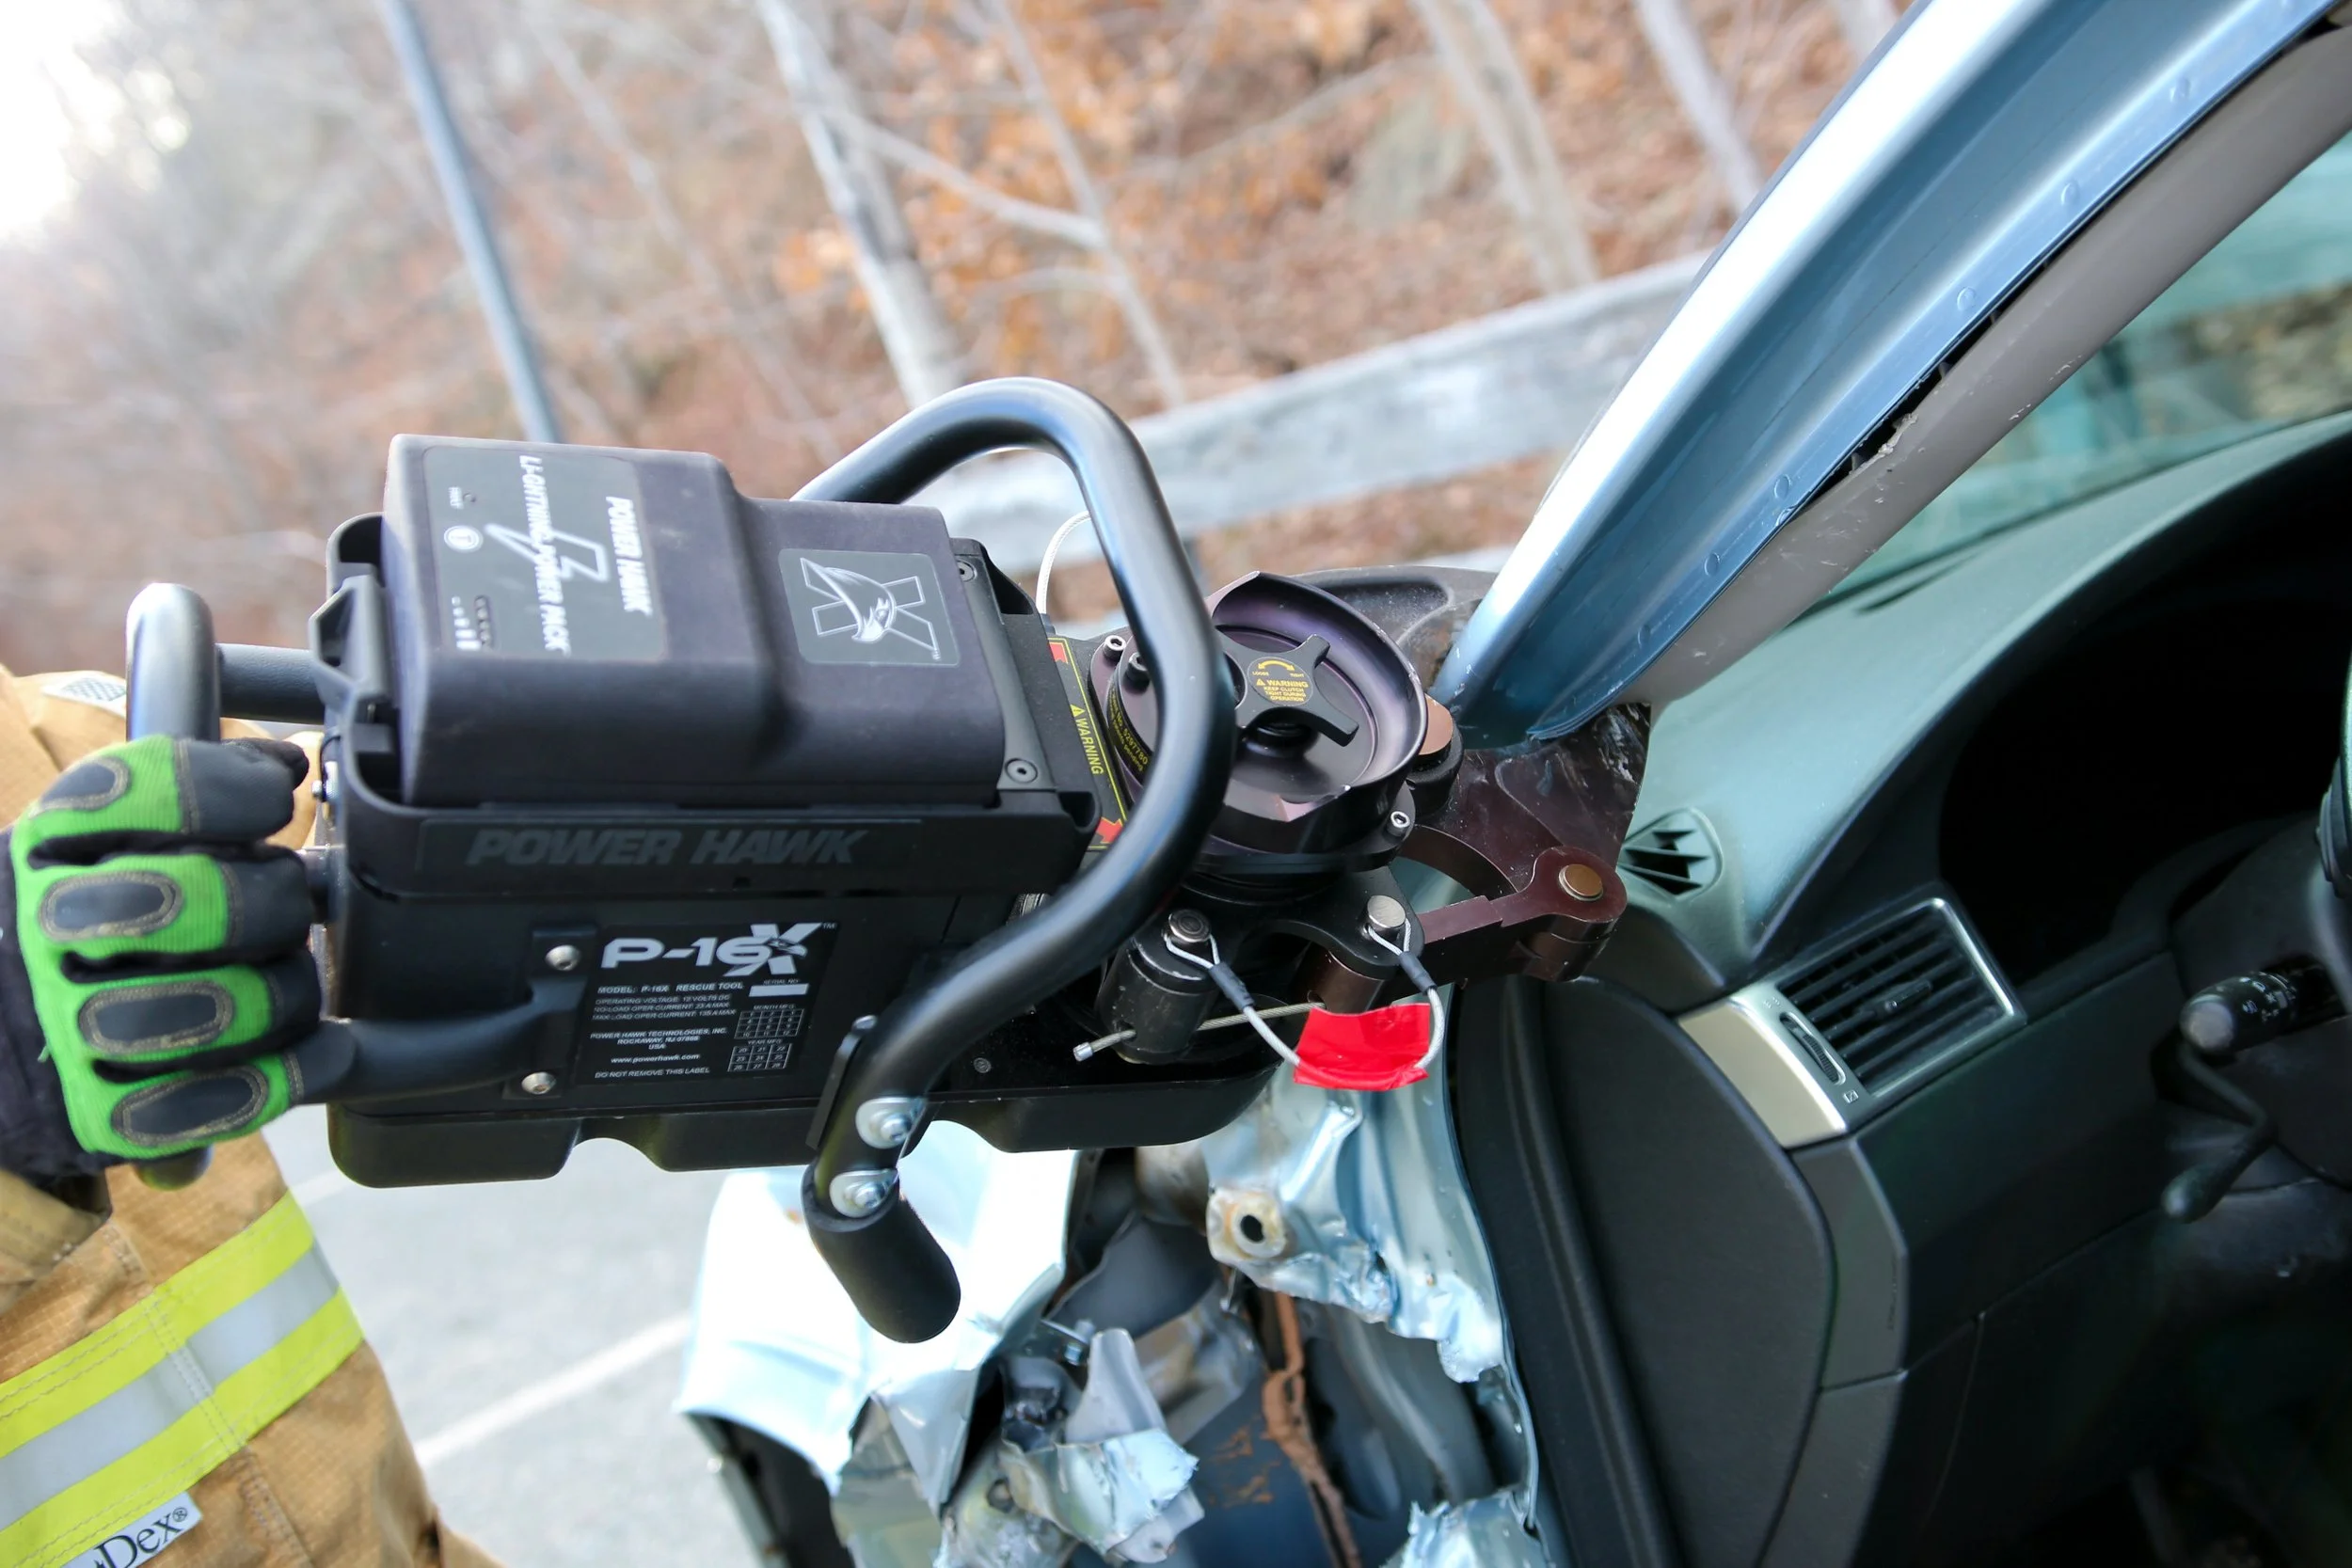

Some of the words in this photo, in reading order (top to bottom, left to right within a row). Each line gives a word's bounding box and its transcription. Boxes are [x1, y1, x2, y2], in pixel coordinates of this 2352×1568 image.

[606, 497, 644, 559] POWER
[532, 543, 564, 604] POWER
[616, 559, 653, 619] HAWK
[539, 603, 571, 657] PACK
[1075, 718, 1104, 775] WARNING
[466, 829, 683, 864] POWER
[690, 829, 868, 864] HAWK
[596, 985, 638, 993] MODEL:
[641, 984, 669, 992] P-16X
[675, 983, 716, 991] RESCUE
[611, 1054, 700, 1064] www.powerhawk.com
